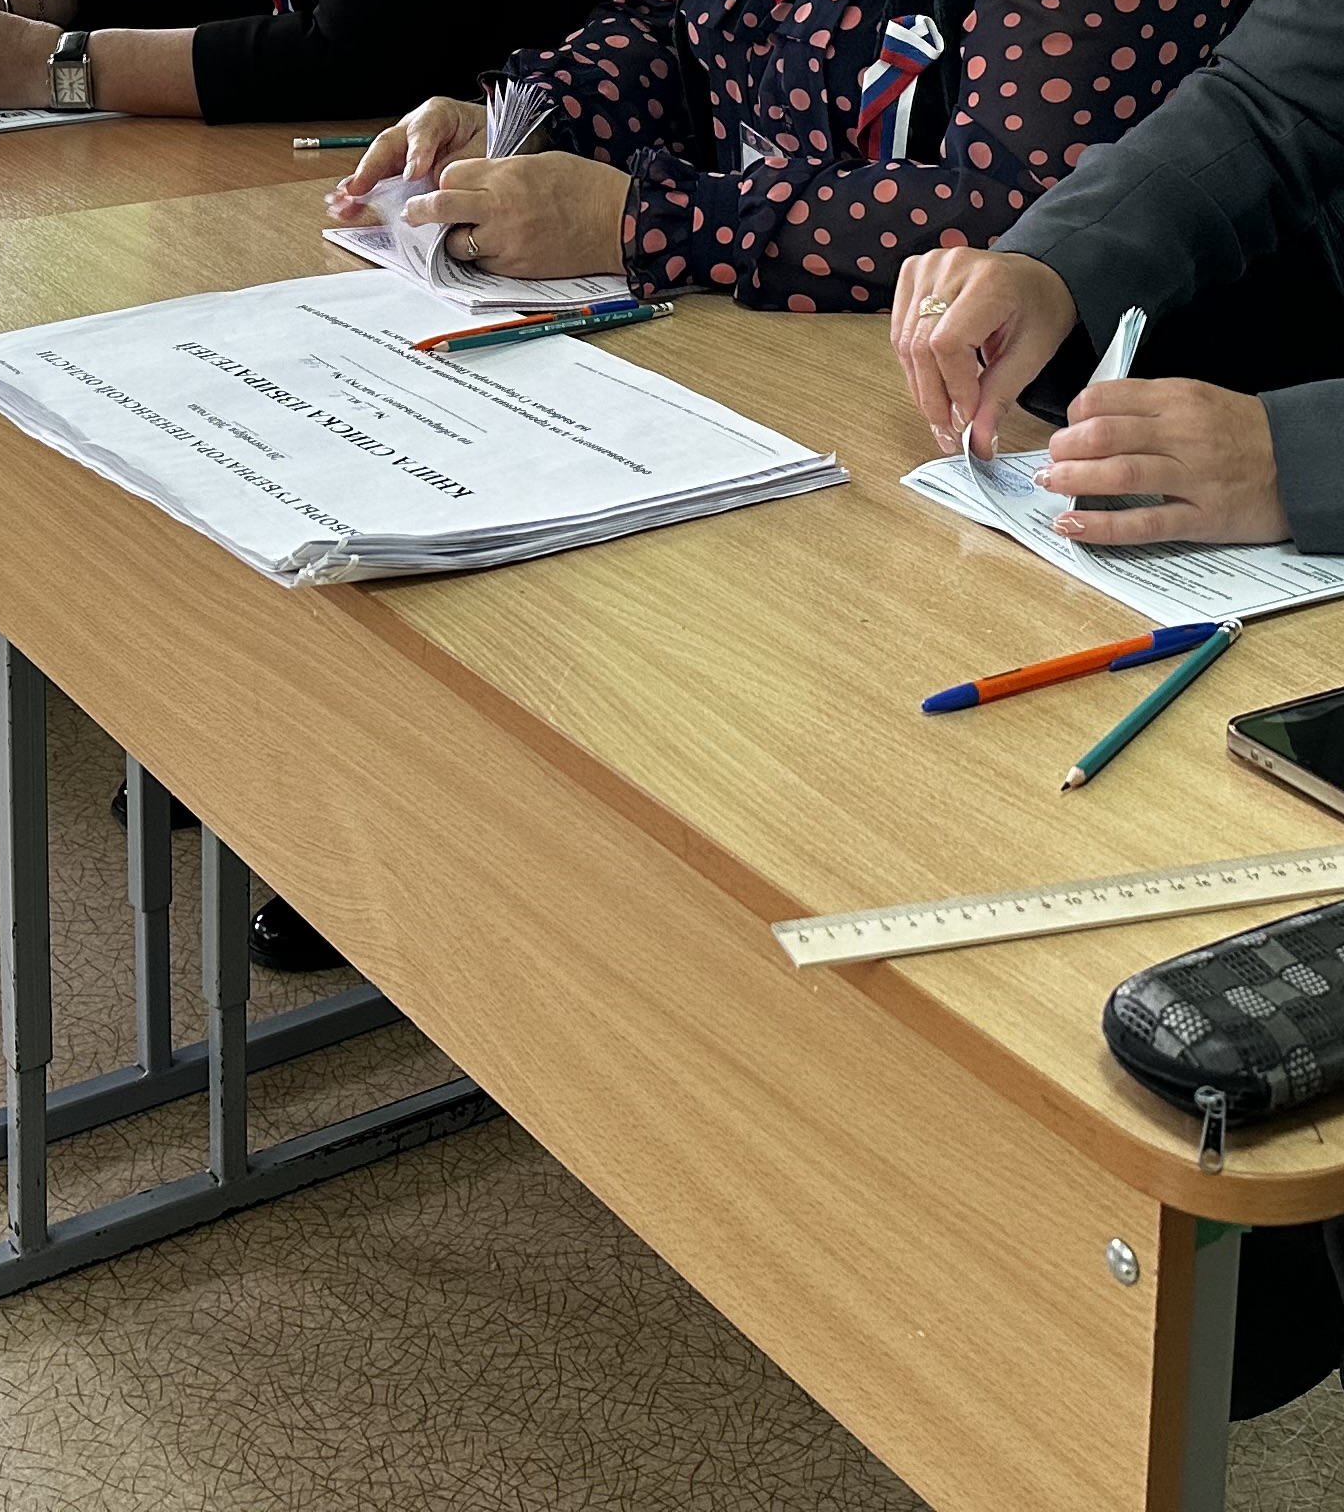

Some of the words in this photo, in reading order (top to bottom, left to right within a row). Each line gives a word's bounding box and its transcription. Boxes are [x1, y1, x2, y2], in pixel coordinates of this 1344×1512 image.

[36, 350, 103, 385] ОБЛАСТИ
[173, 342, 313, 411] ИЗБИРАТЕЛЕЙ
[93, 385, 196, 441] ПЕНЗЕНСКОЙ
[307, 410, 395, 456] СПИСКА
[190, 440, 302, 504] ГУБЕРНАТОРА
[392, 456, 474, 499] КНИГА
[294, 504, 369, 540] ЫБОРЫ
